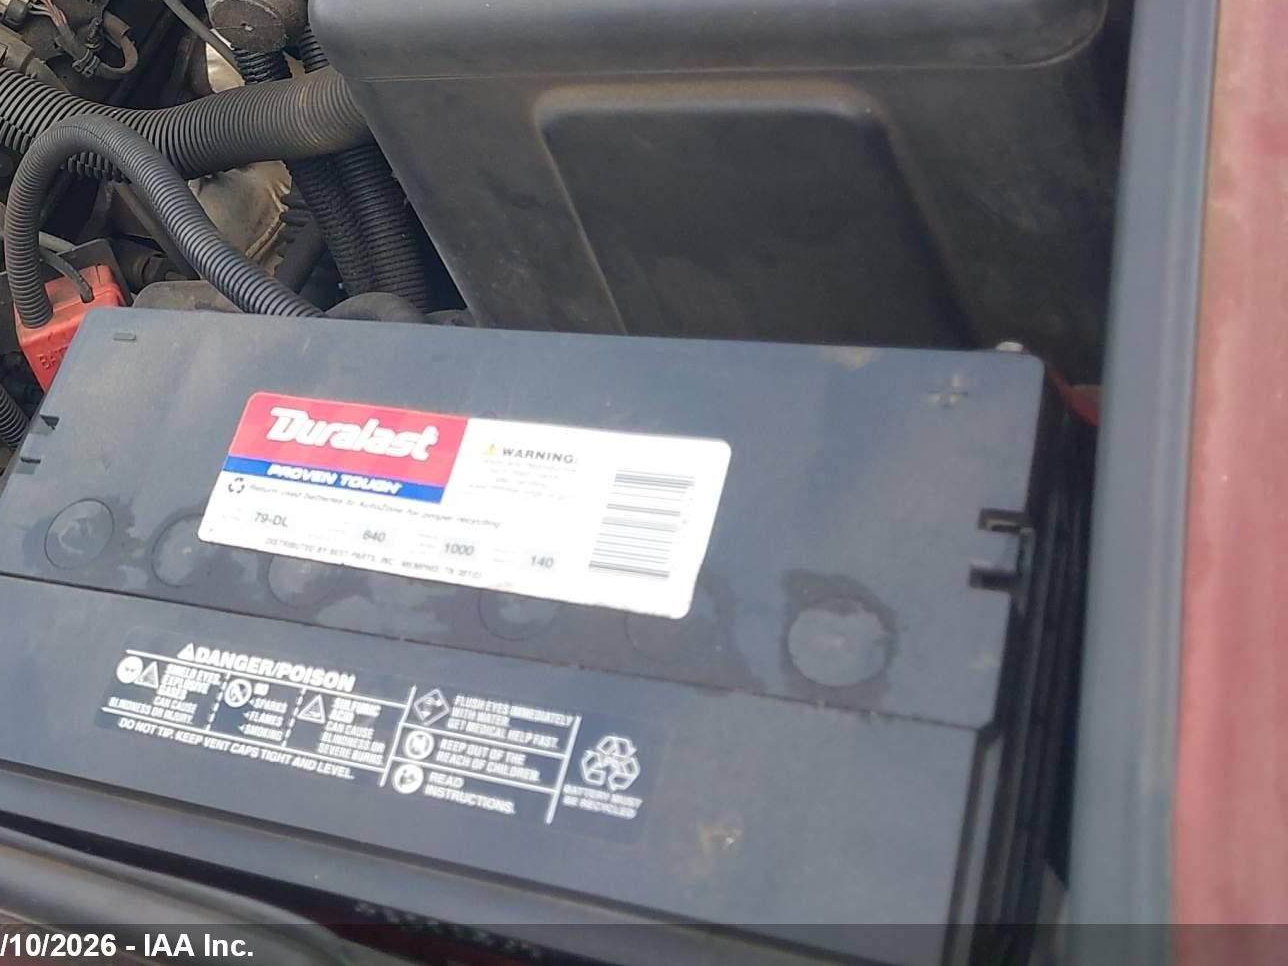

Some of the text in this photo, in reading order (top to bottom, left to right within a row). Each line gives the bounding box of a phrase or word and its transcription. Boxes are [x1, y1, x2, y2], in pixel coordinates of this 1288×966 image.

[265, 406, 441, 461] Duralast
[502, 446, 578, 465] WARNING:
[267, 463, 402, 494] PROVEN TOUGH
[253, 511, 289, 528] 79-DL
[443, 541, 475, 557] 1000
[529, 555, 555, 569] 140
[195, 646, 356, 692] DANGER/POISON
[161, 674, 211, 694] EXPLOSIVE
[108, 696, 152, 714] BLINDNESS
[152, 706, 164, 718] OR
[153, 696, 198, 714] CAN CAUSE
[252, 697, 288, 714] SPARKS
[333, 697, 382, 717] SULFURIC
[454, 694, 574, 727] FLUSH EYES IMMEDIATELY
[248, 711, 284, 727] FLAMES
[329, 709, 355, 724] ACID
[452, 706, 510, 727] WITH WATER
[244, 724, 284, 741] SMOKING
[325, 720, 375, 740] CAN CAUSE
[447, 718, 559, 749] GET MEDICAL HELP FAST.
[118, 717, 355, 779] DO NOT TIP. KEEP VENT CAPS TIGHT AND LEVEL.
[318, 742, 352, 758] SEVERE
[321, 731, 386, 753] BLINDNESS OR
[439, 738, 527, 766] KEEP OUT OF THE
[436, 750, 541, 782] REACH OF CHILDREN.
[429, 771, 465, 789] READ
[424, 784, 515, 814] INSTRUCTIONS.
